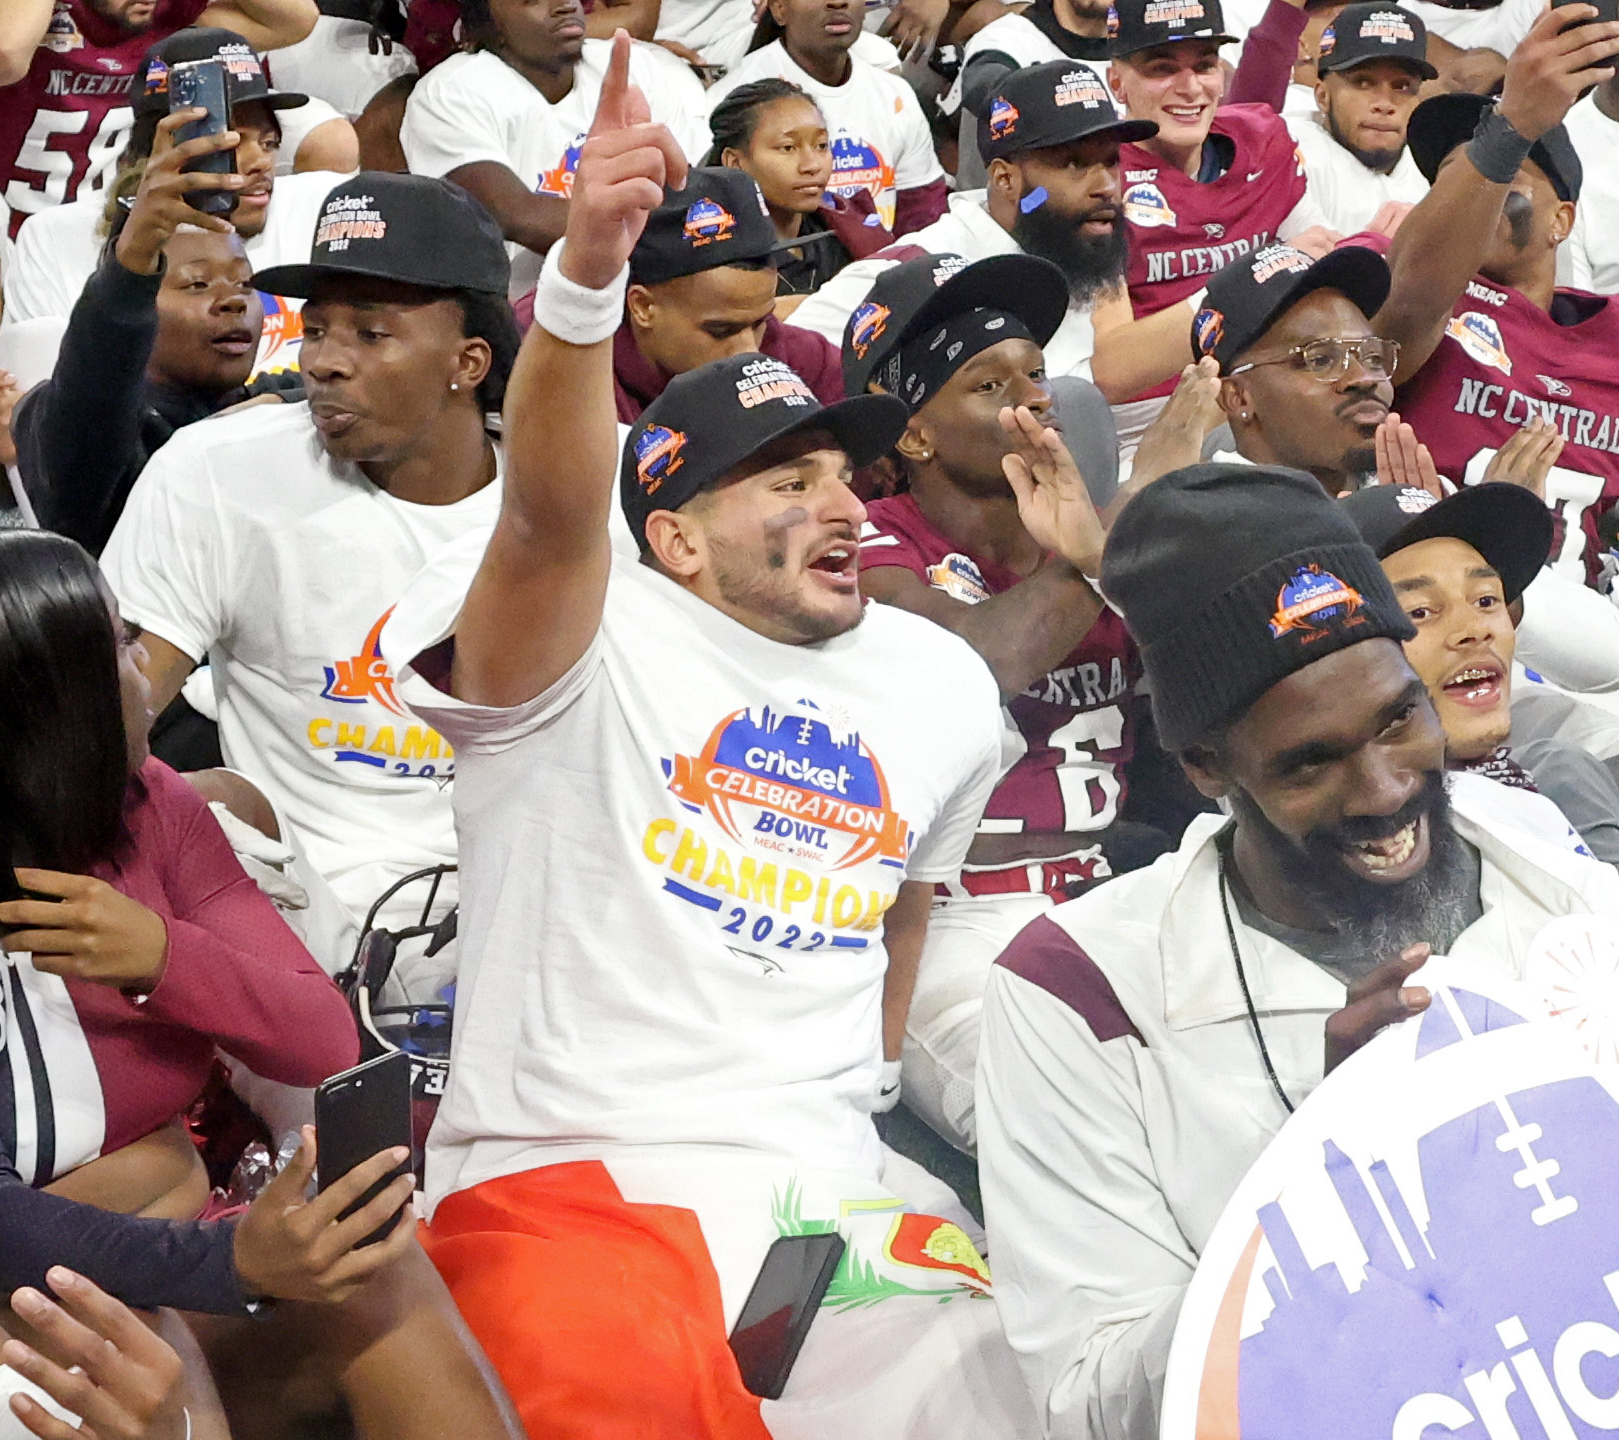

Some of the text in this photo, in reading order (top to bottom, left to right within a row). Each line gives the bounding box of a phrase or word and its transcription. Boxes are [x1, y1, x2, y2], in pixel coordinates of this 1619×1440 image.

[1370, 2, 1405, 16] cricket
[216, 43, 251, 57] cricket
[44, 68, 72, 95] NC
[1060, 71, 1097, 86] cricket
[1125, 170, 1159, 183] MEAC
[324, 194, 373, 213] cricket
[326, 240, 350, 253] 2022
[1147, 254, 1175, 282] NC
[1464, 282, 1509, 307] MEAC
[740, 358, 792, 380] cricket
[1454, 379, 1502, 414] NC
[1292, 581, 1337, 606] cricket
[1283, 594, 1361, 620] CELEBRATION
[742, 744, 853, 796] cricket
[704, 766, 886, 835] CELEBRATION
[755, 810, 829, 851] BOWL
[754, 836, 825, 864] MEAC SWAC
[721, 907, 827, 955] 2022
